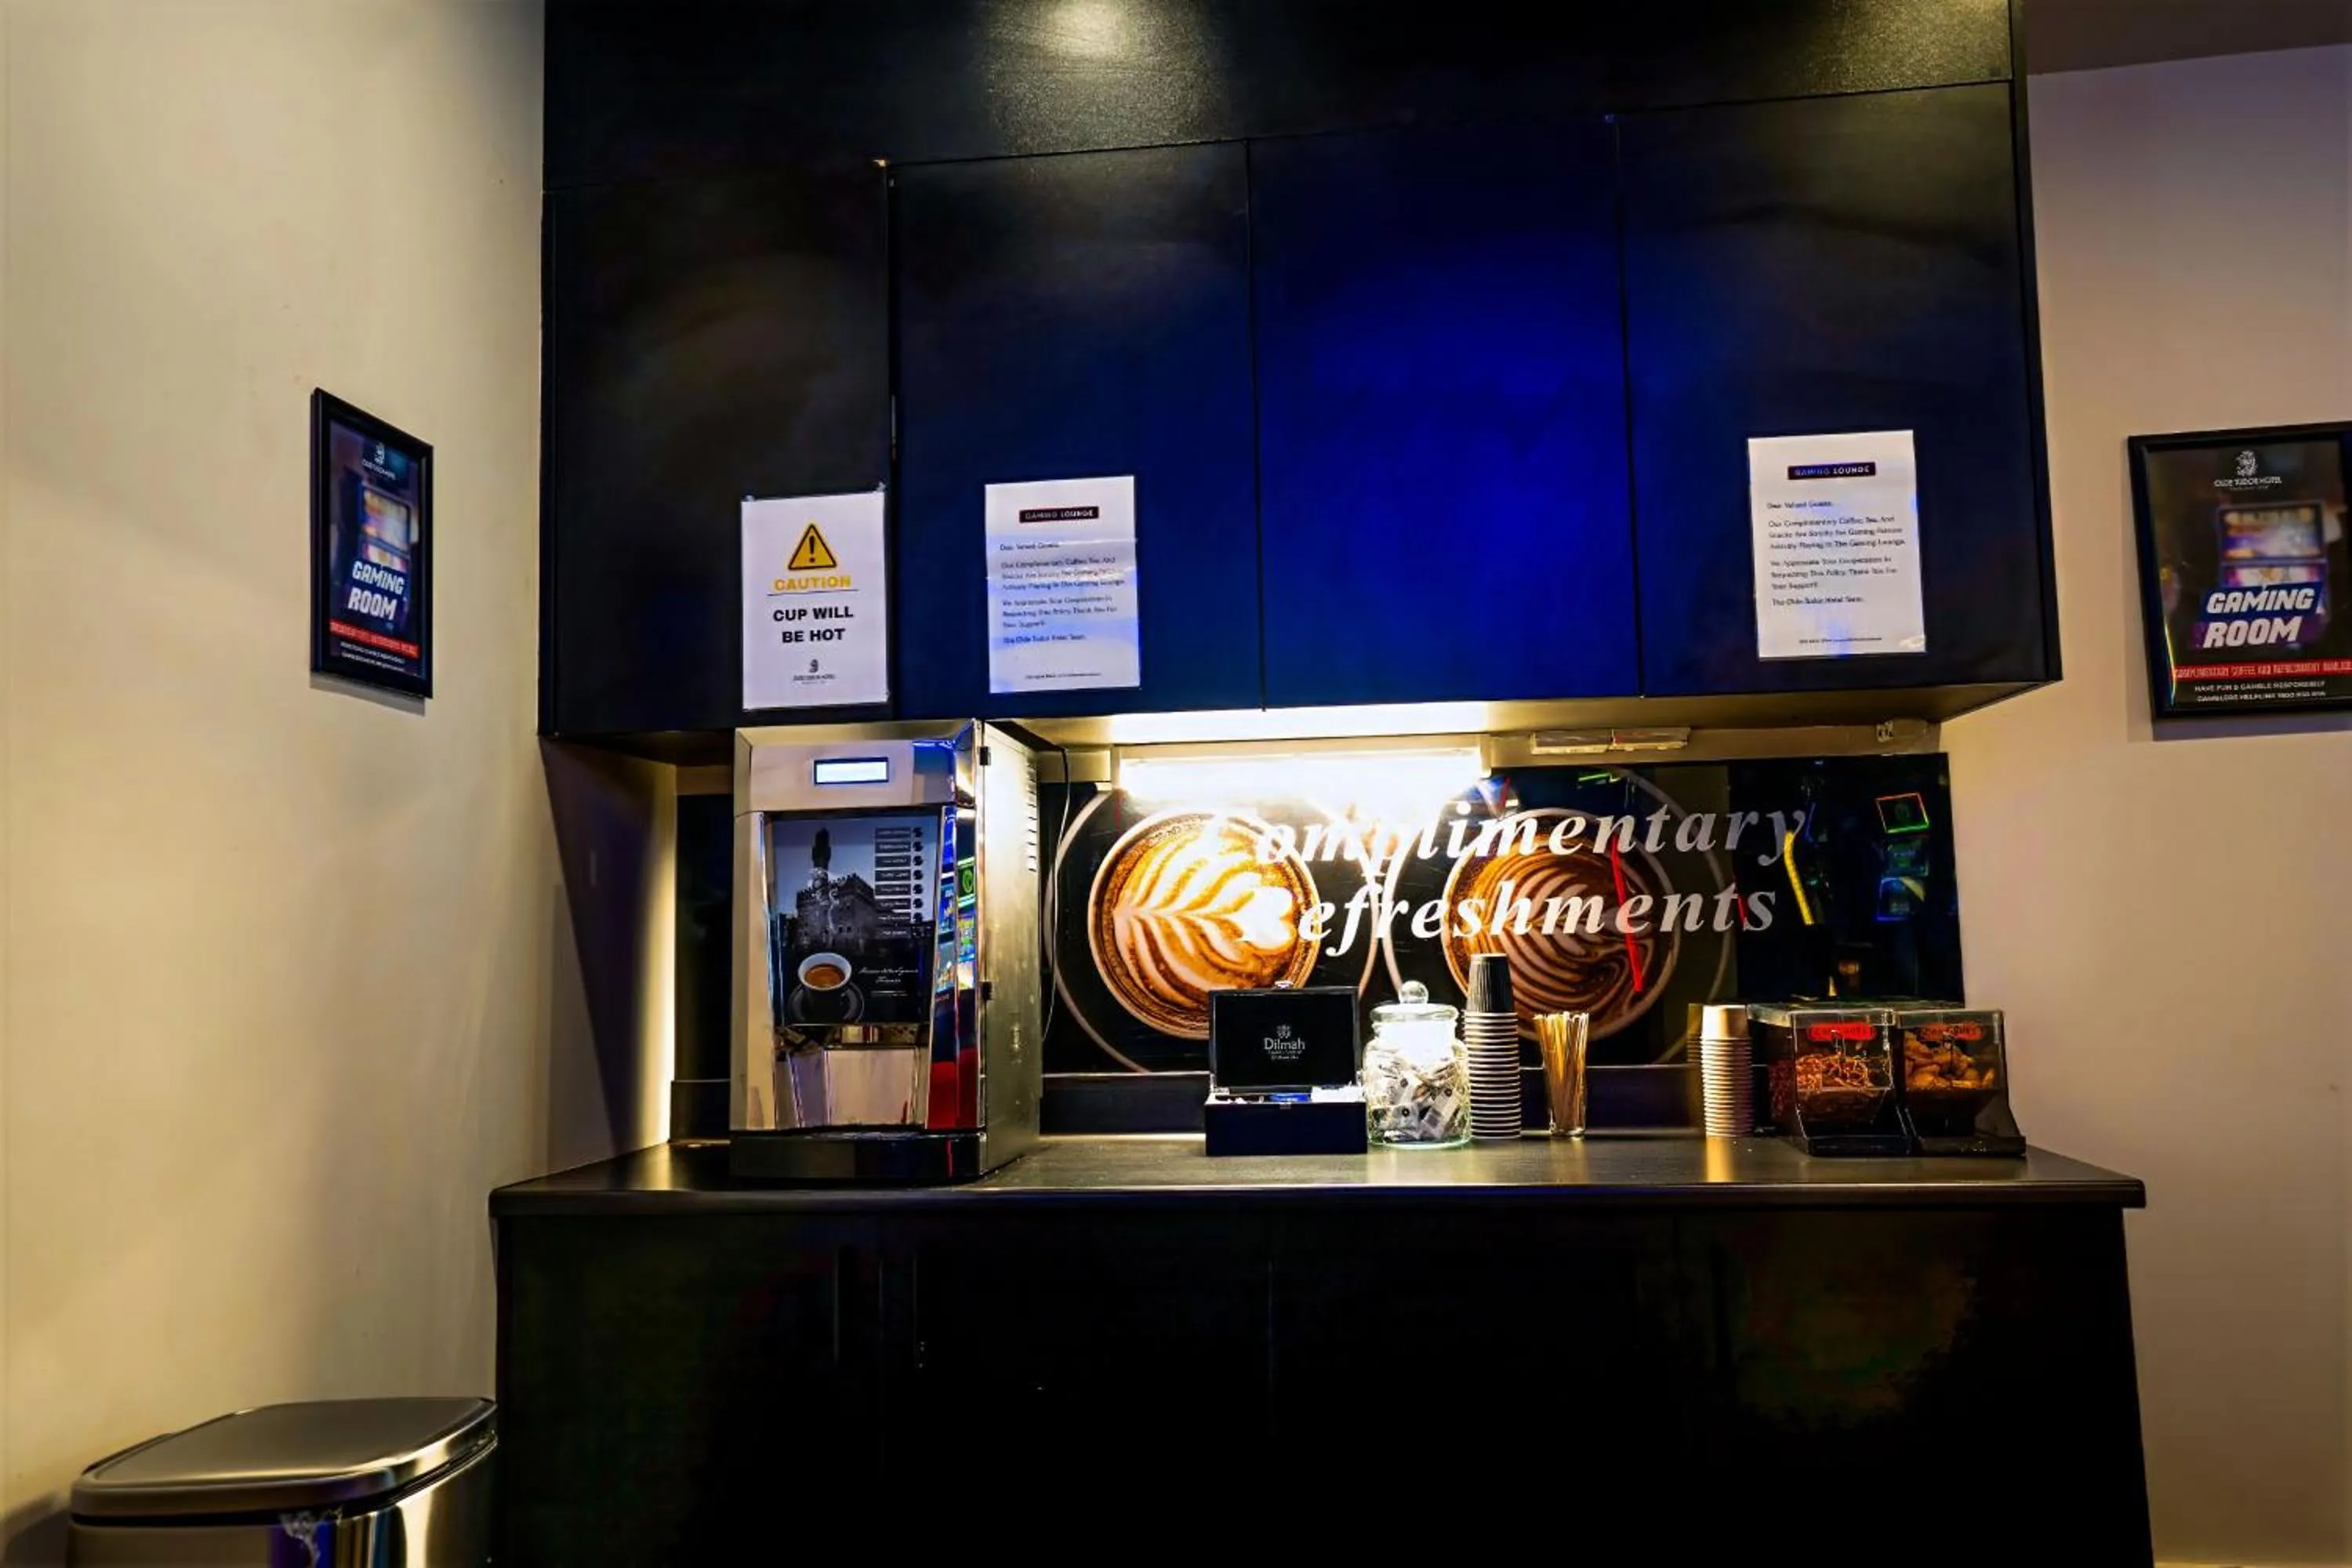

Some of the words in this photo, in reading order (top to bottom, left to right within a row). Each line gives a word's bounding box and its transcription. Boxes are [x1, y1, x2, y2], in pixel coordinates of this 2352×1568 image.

[352, 560, 405, 596] GAMING
[773, 575, 852, 592] CAUTION
[347, 585, 398, 621] ROOM
[772, 608, 808, 622] CUP
[812, 606, 855, 620] WILL
[2205, 587, 2316, 615] GAMING
[782, 630, 804, 644] BE
[809, 628, 846, 642] HOT
[2202, 615, 2303, 649] ROOM
[1257, 795, 1806, 877] omplimentary
[1296, 880, 1777, 957] efreshments
[1264, 1036, 1305, 1050] Dilmah
